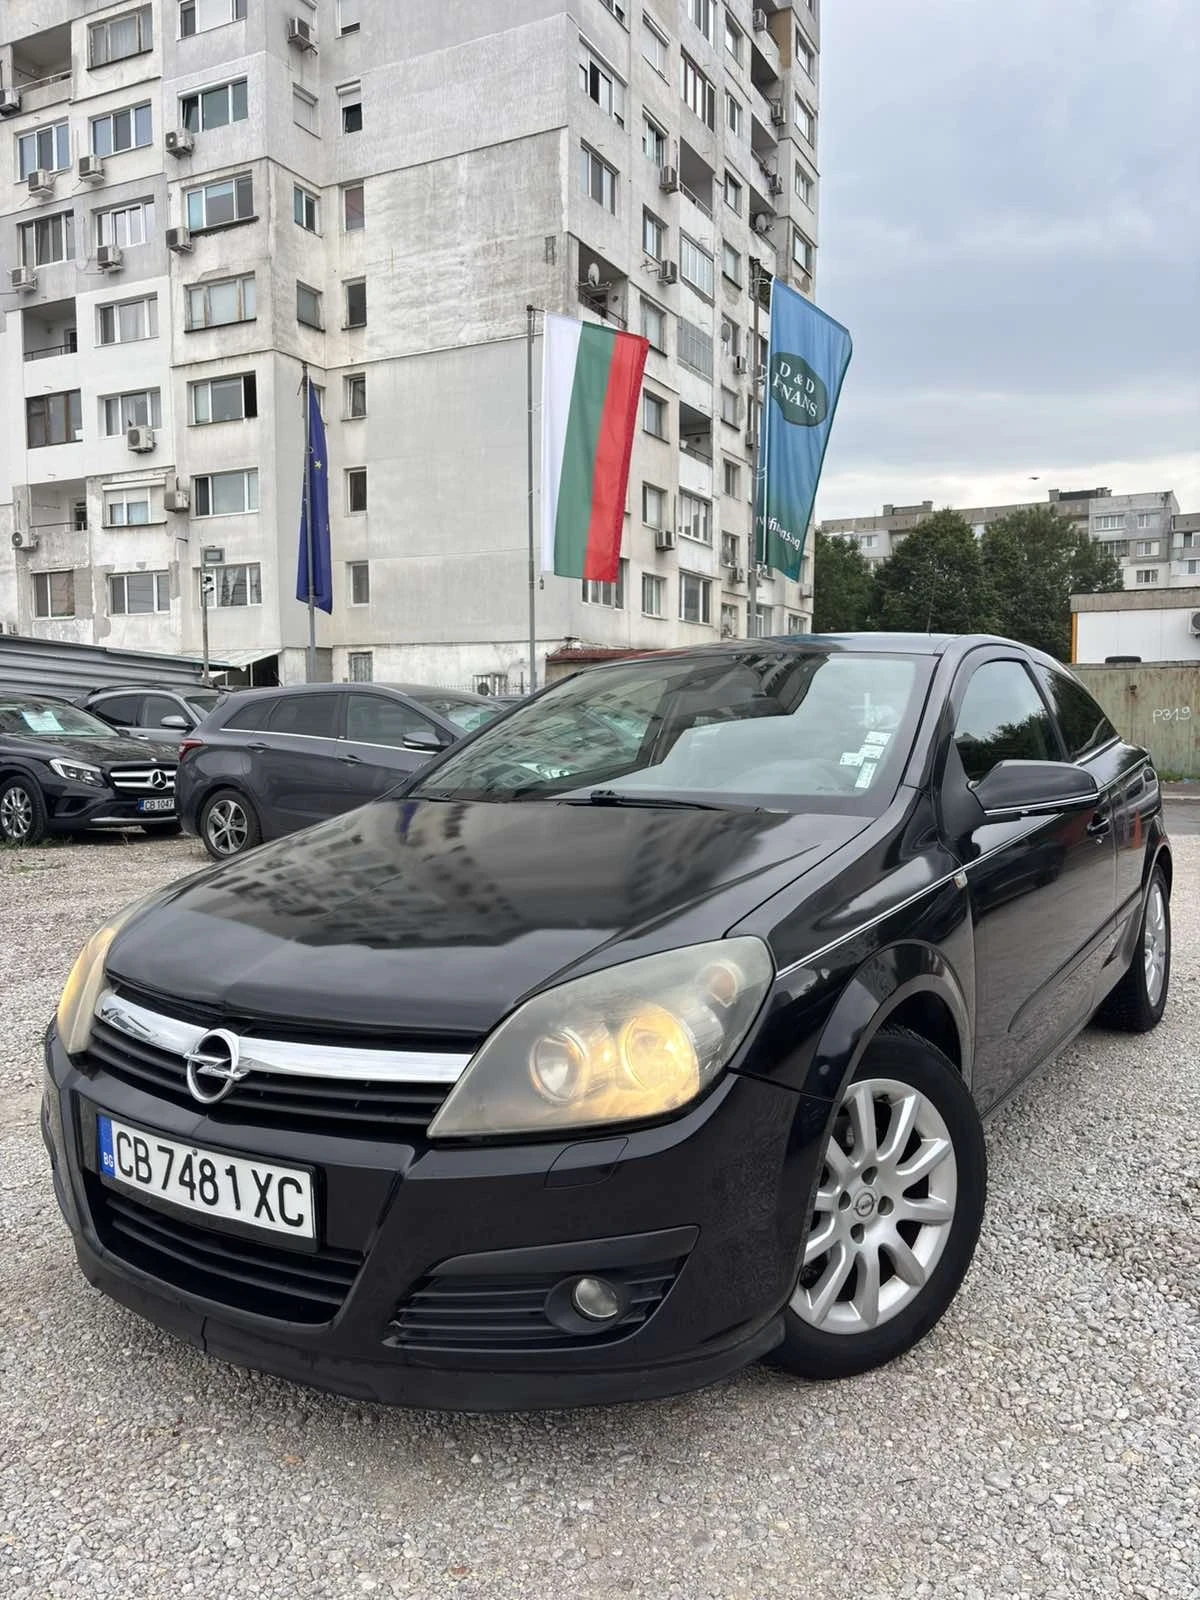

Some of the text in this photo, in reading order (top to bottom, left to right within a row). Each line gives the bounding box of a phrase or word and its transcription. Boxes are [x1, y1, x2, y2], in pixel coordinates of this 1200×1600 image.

[780, 361, 815, 394] D & D
[103, 1151, 114, 1167] BG
